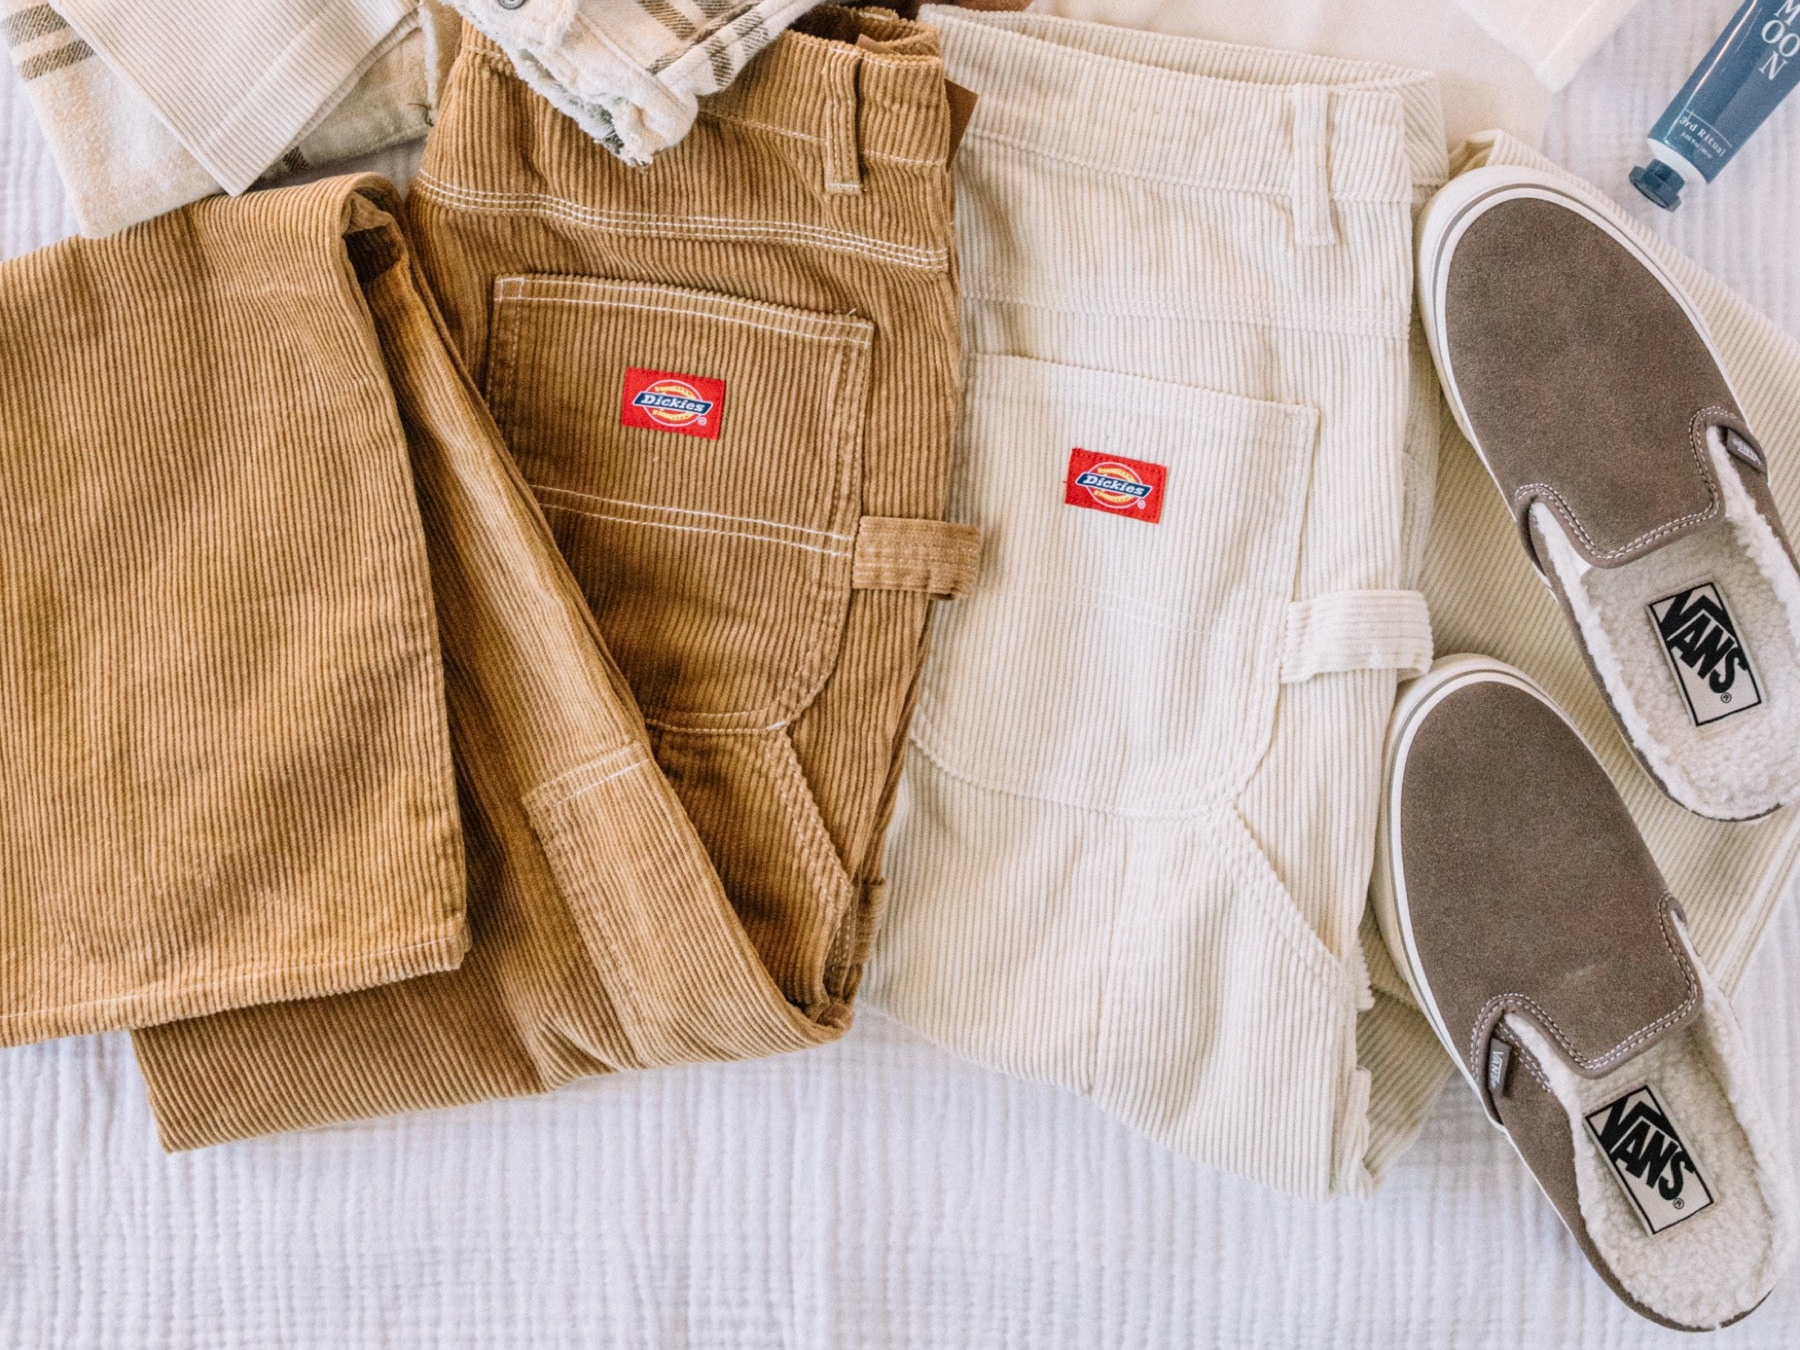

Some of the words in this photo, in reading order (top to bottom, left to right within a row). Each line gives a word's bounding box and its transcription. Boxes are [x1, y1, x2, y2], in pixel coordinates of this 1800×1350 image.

[1679, 116, 1698, 132] 3rd
[1697, 128, 1727, 157] Ritual
[640, 394, 706, 413] Dickies
[1082, 474, 1145, 495] Dickies
[1659, 589, 1749, 694] VANS
[1598, 1096, 1695, 1201] VANS
